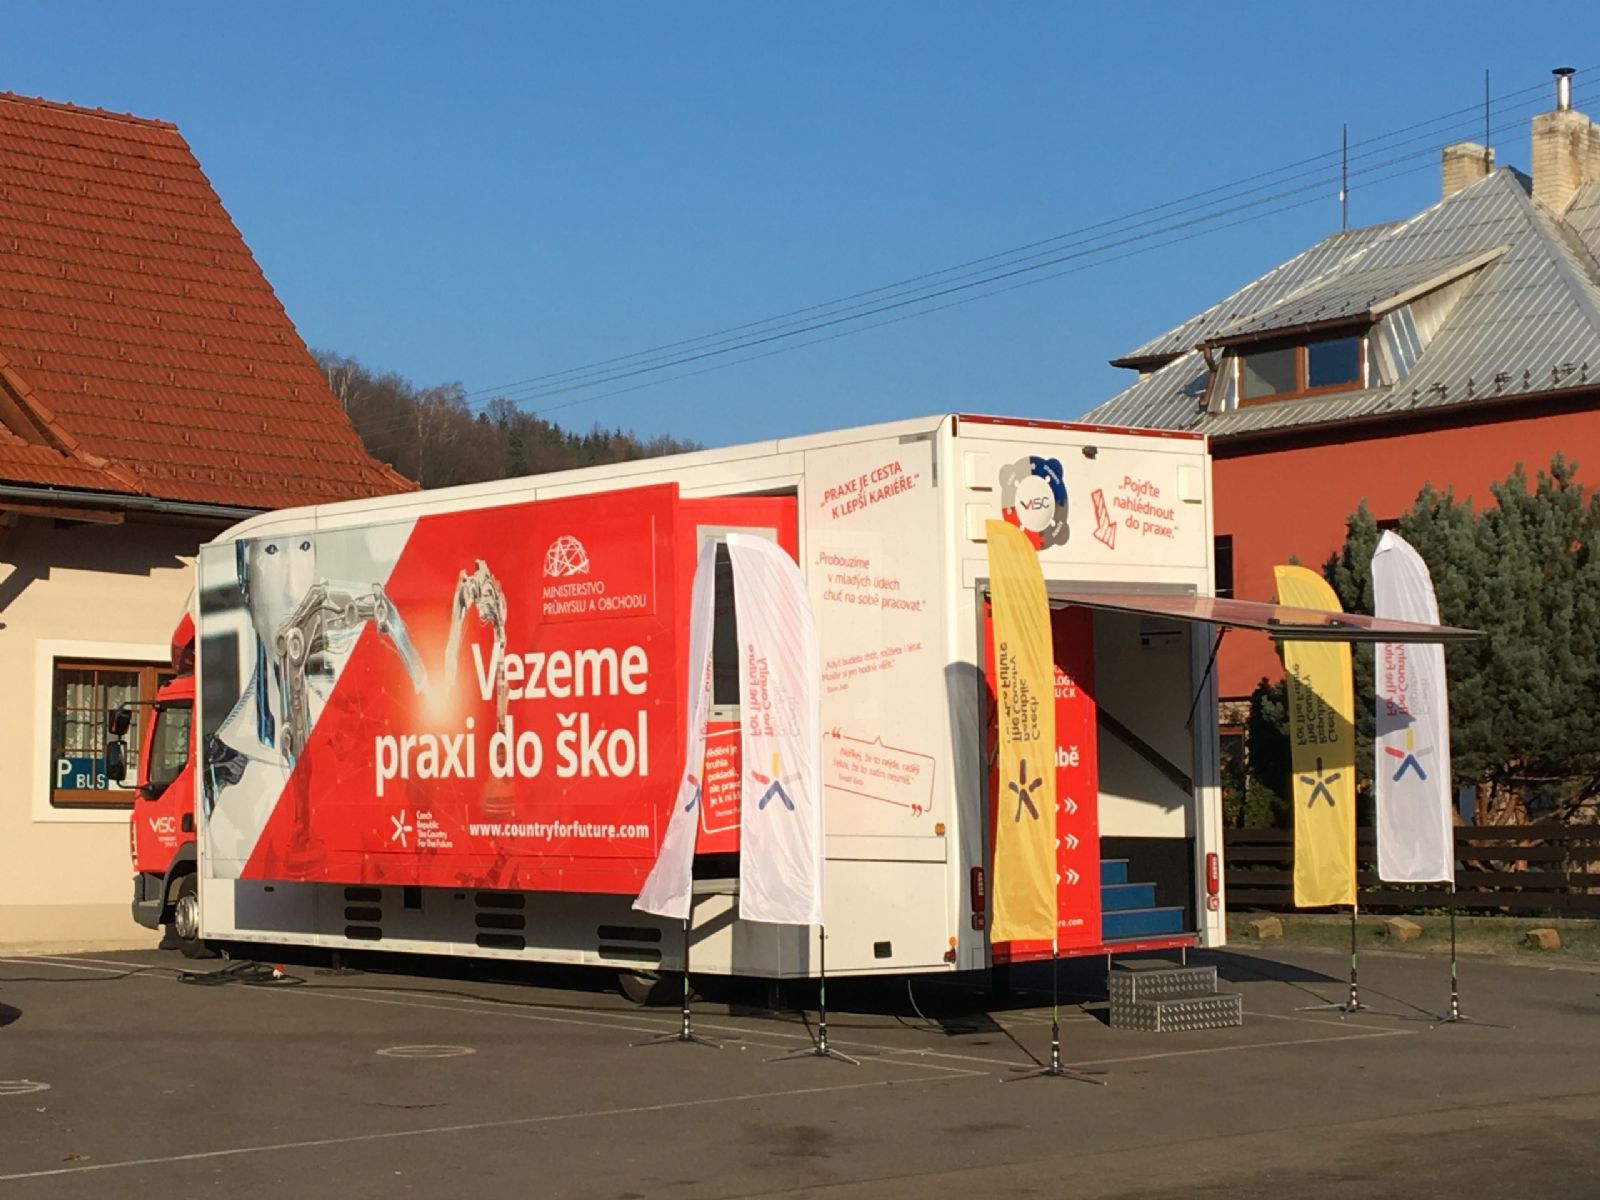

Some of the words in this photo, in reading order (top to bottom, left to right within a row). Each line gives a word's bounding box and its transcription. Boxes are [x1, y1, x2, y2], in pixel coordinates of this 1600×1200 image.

[858, 474, 869, 493] JE
[870, 461, 902, 483] CESTA
[832, 506, 840, 520] K
[841, 491, 867, 516] LEPŠÍ
[1113, 496, 1175, 521] nahlédnout
[1125, 515, 1140, 530] do
[543, 581, 605, 599] MINISTERSTVO
[835, 573, 871, 589] mladých
[543, 600, 587, 615] PRŮMYSLU
[588, 599, 597, 612] A
[597, 594, 647, 611] OBCHODU
[844, 593, 856, 604] na
[857, 593, 880, 606] sobě
[471, 643, 649, 701] Vezeme
[375, 716, 476, 797] praxi
[489, 714, 543, 778] do
[556, 710, 649, 778] škol
[57, 759, 73, 788] P
[76, 773, 106, 789] BUS
[469, 821, 649, 842] www.countryforfuture.com
